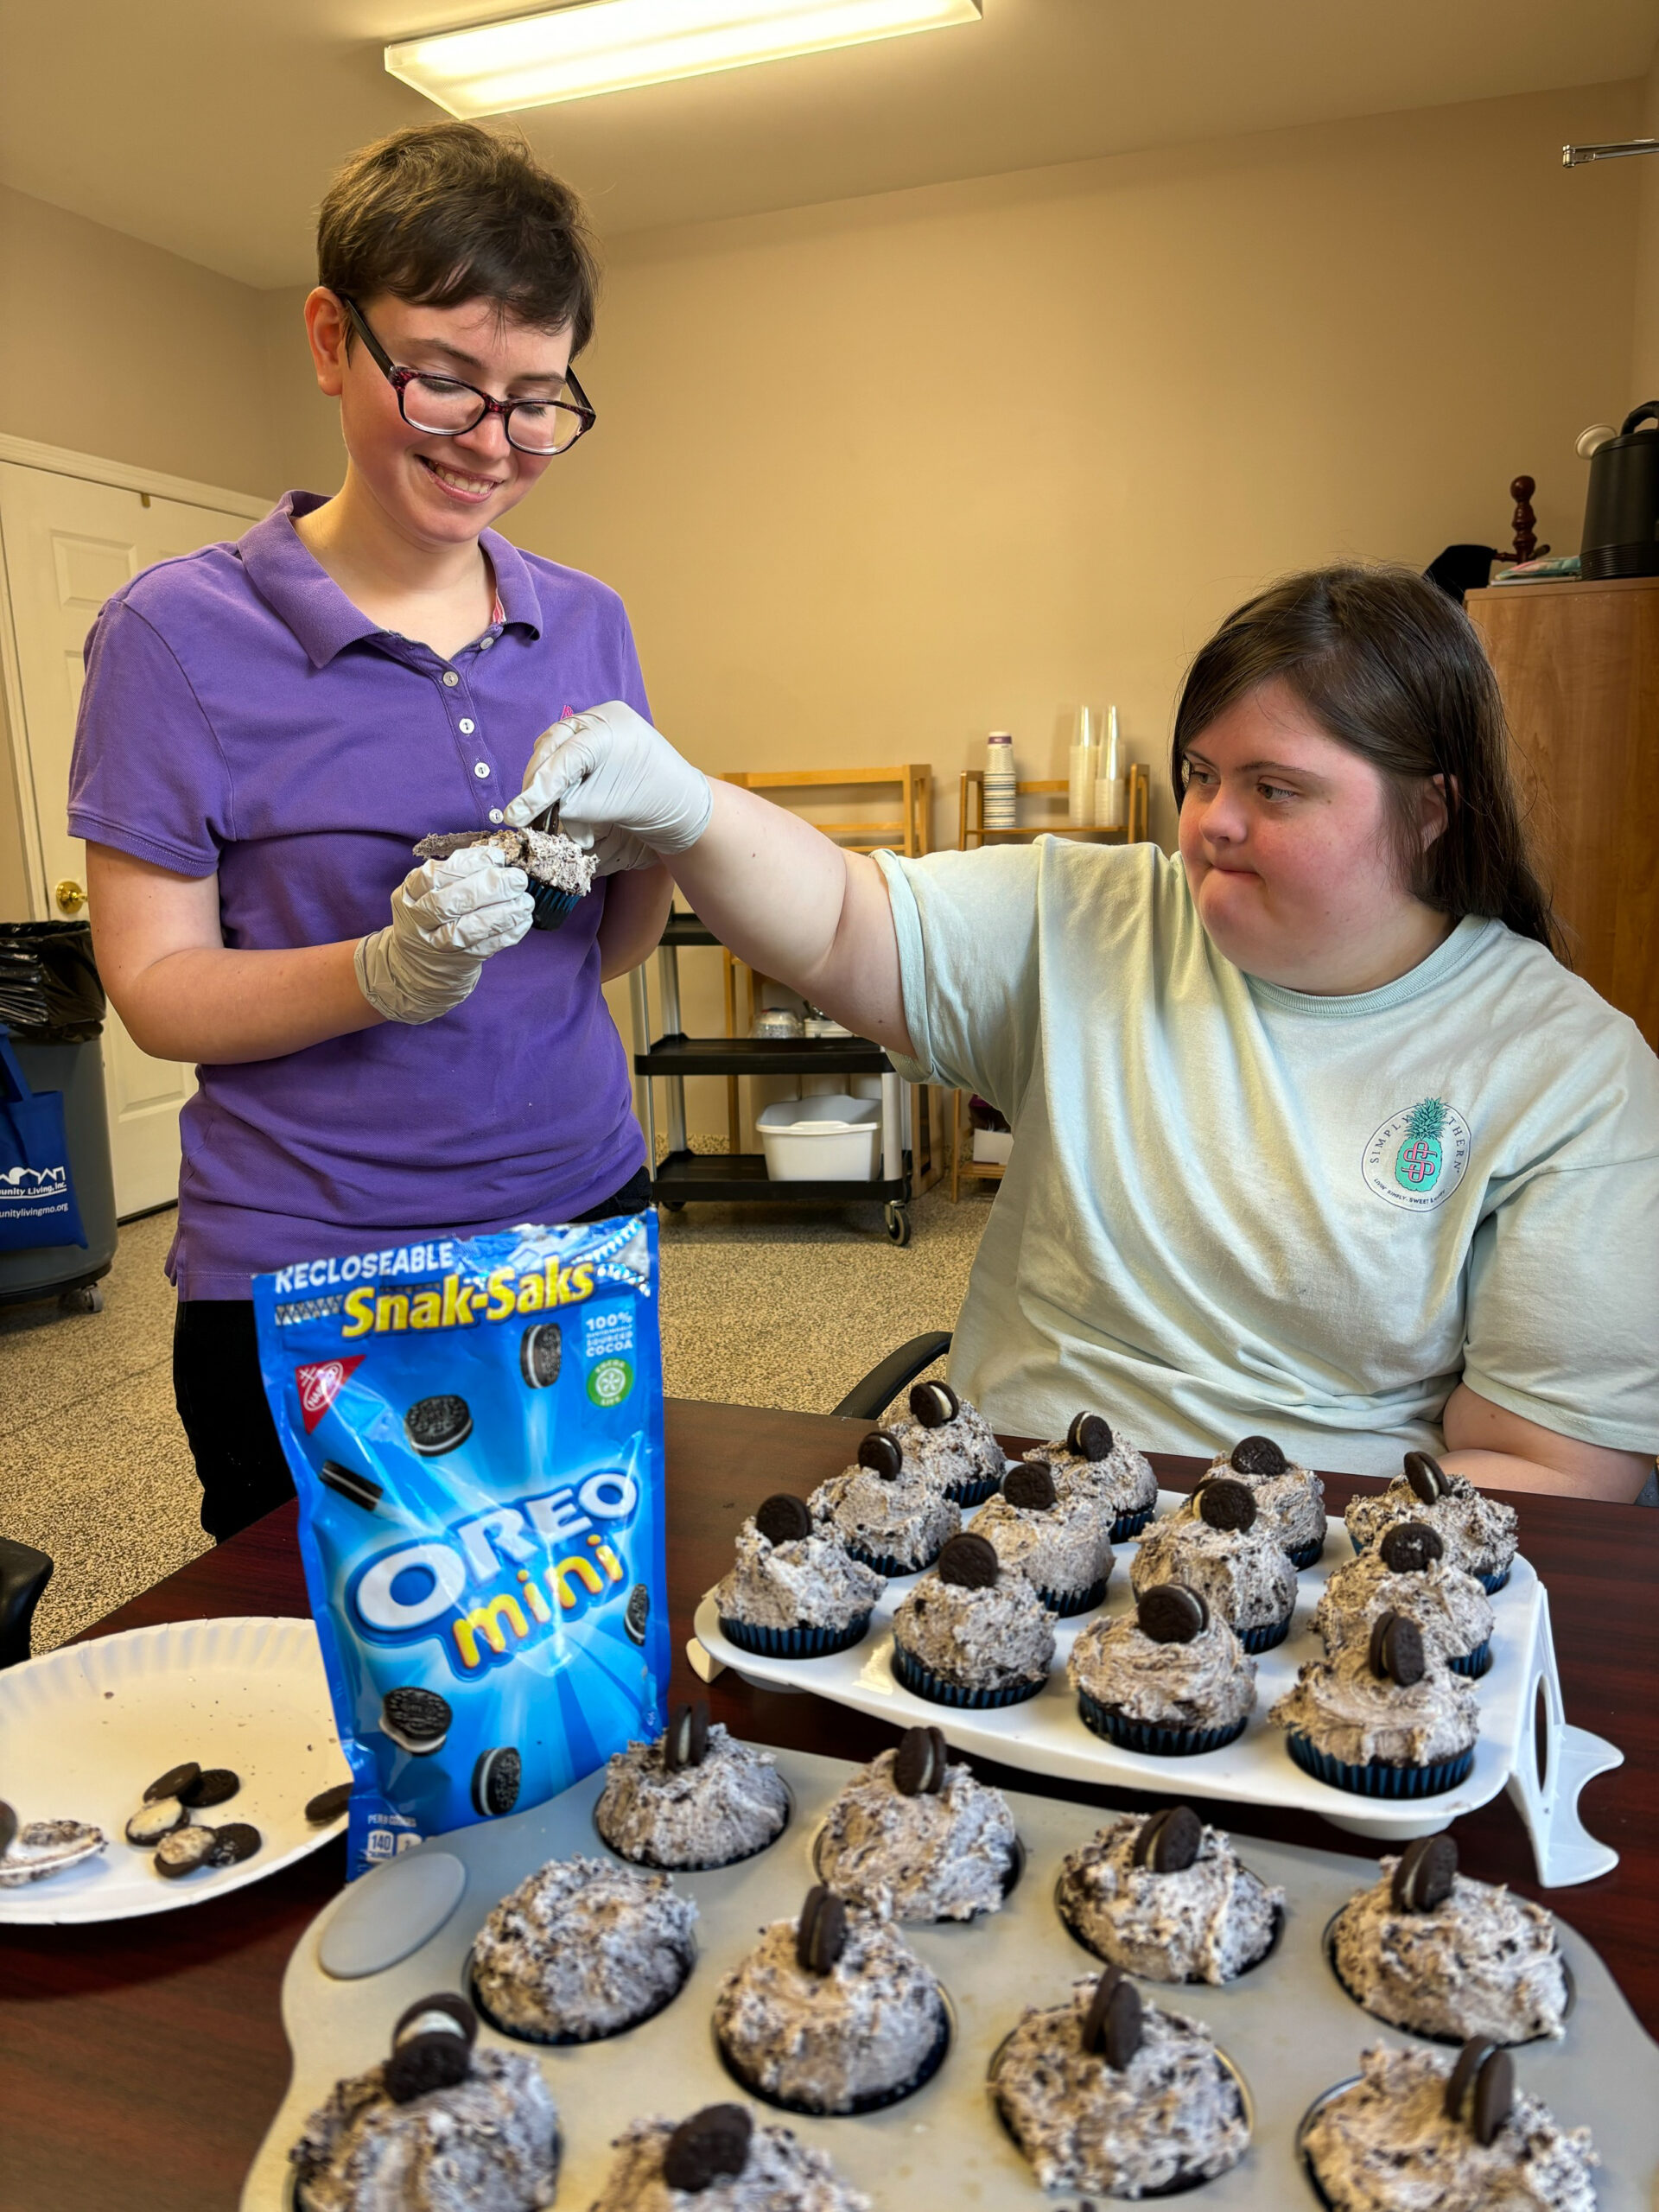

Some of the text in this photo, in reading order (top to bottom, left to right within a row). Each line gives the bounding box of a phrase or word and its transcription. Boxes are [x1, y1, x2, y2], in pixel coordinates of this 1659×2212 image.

[28, 1185, 54, 1195] Living,
[274, 1242, 454, 1294] RECLOSEABLE
[341, 1255, 595, 1338] Snak-Saks
[585, 1311, 633, 1332] 100%
[585, 1338, 633, 1357] COCOA
[357, 1472, 638, 1631] OREO
[452, 1534, 624, 1669] mini
[372, 1834, 391, 1851] 140
